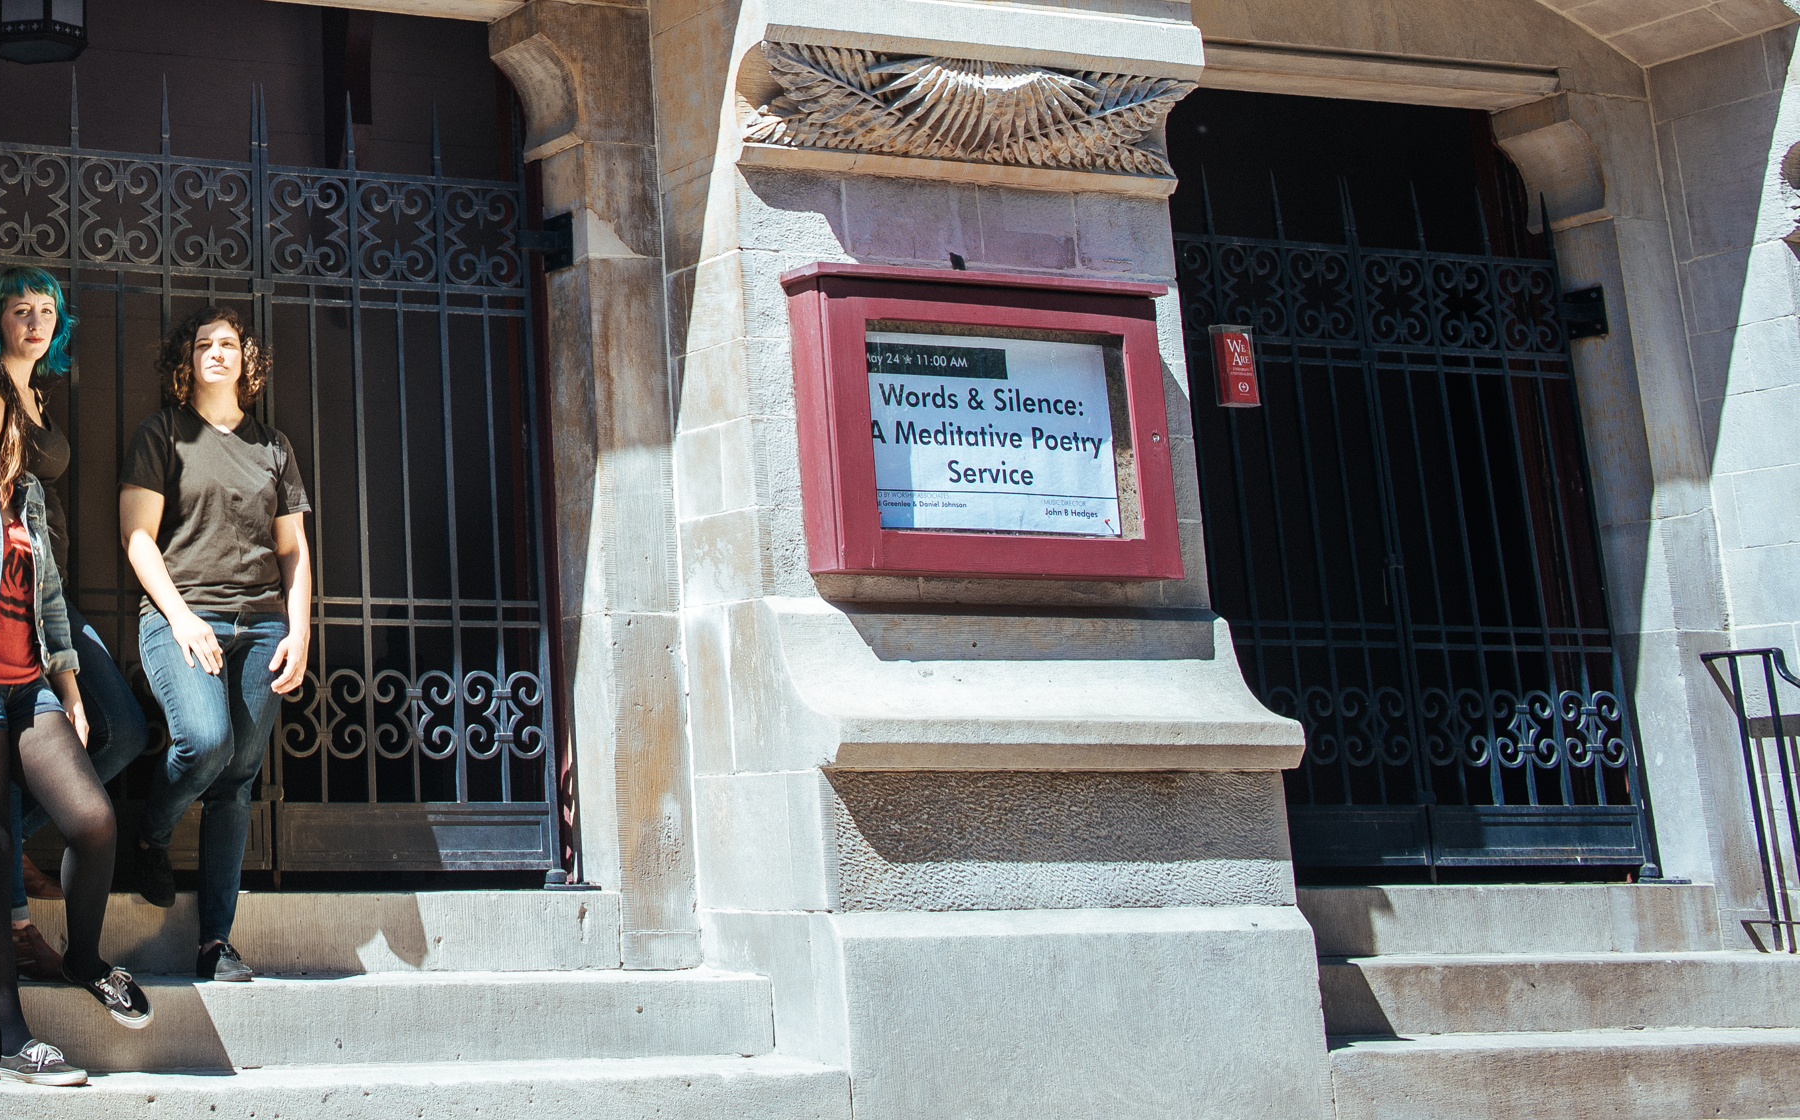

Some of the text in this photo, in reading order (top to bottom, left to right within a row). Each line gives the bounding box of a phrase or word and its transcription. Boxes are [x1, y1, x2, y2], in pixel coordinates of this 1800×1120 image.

[885, 353, 900, 364] 24
[916, 354, 947, 367] 11:00
[950, 357, 968, 368] AM
[879, 382, 1084, 417] Words & Silence:
[872, 419, 1103, 459] A Meditative Poetry
[947, 460, 1034, 486] Service
[919, 500, 940, 508] Daniel
[941, 501, 967, 509] Johnson
[1045, 507, 1098, 520] John B Hedges
